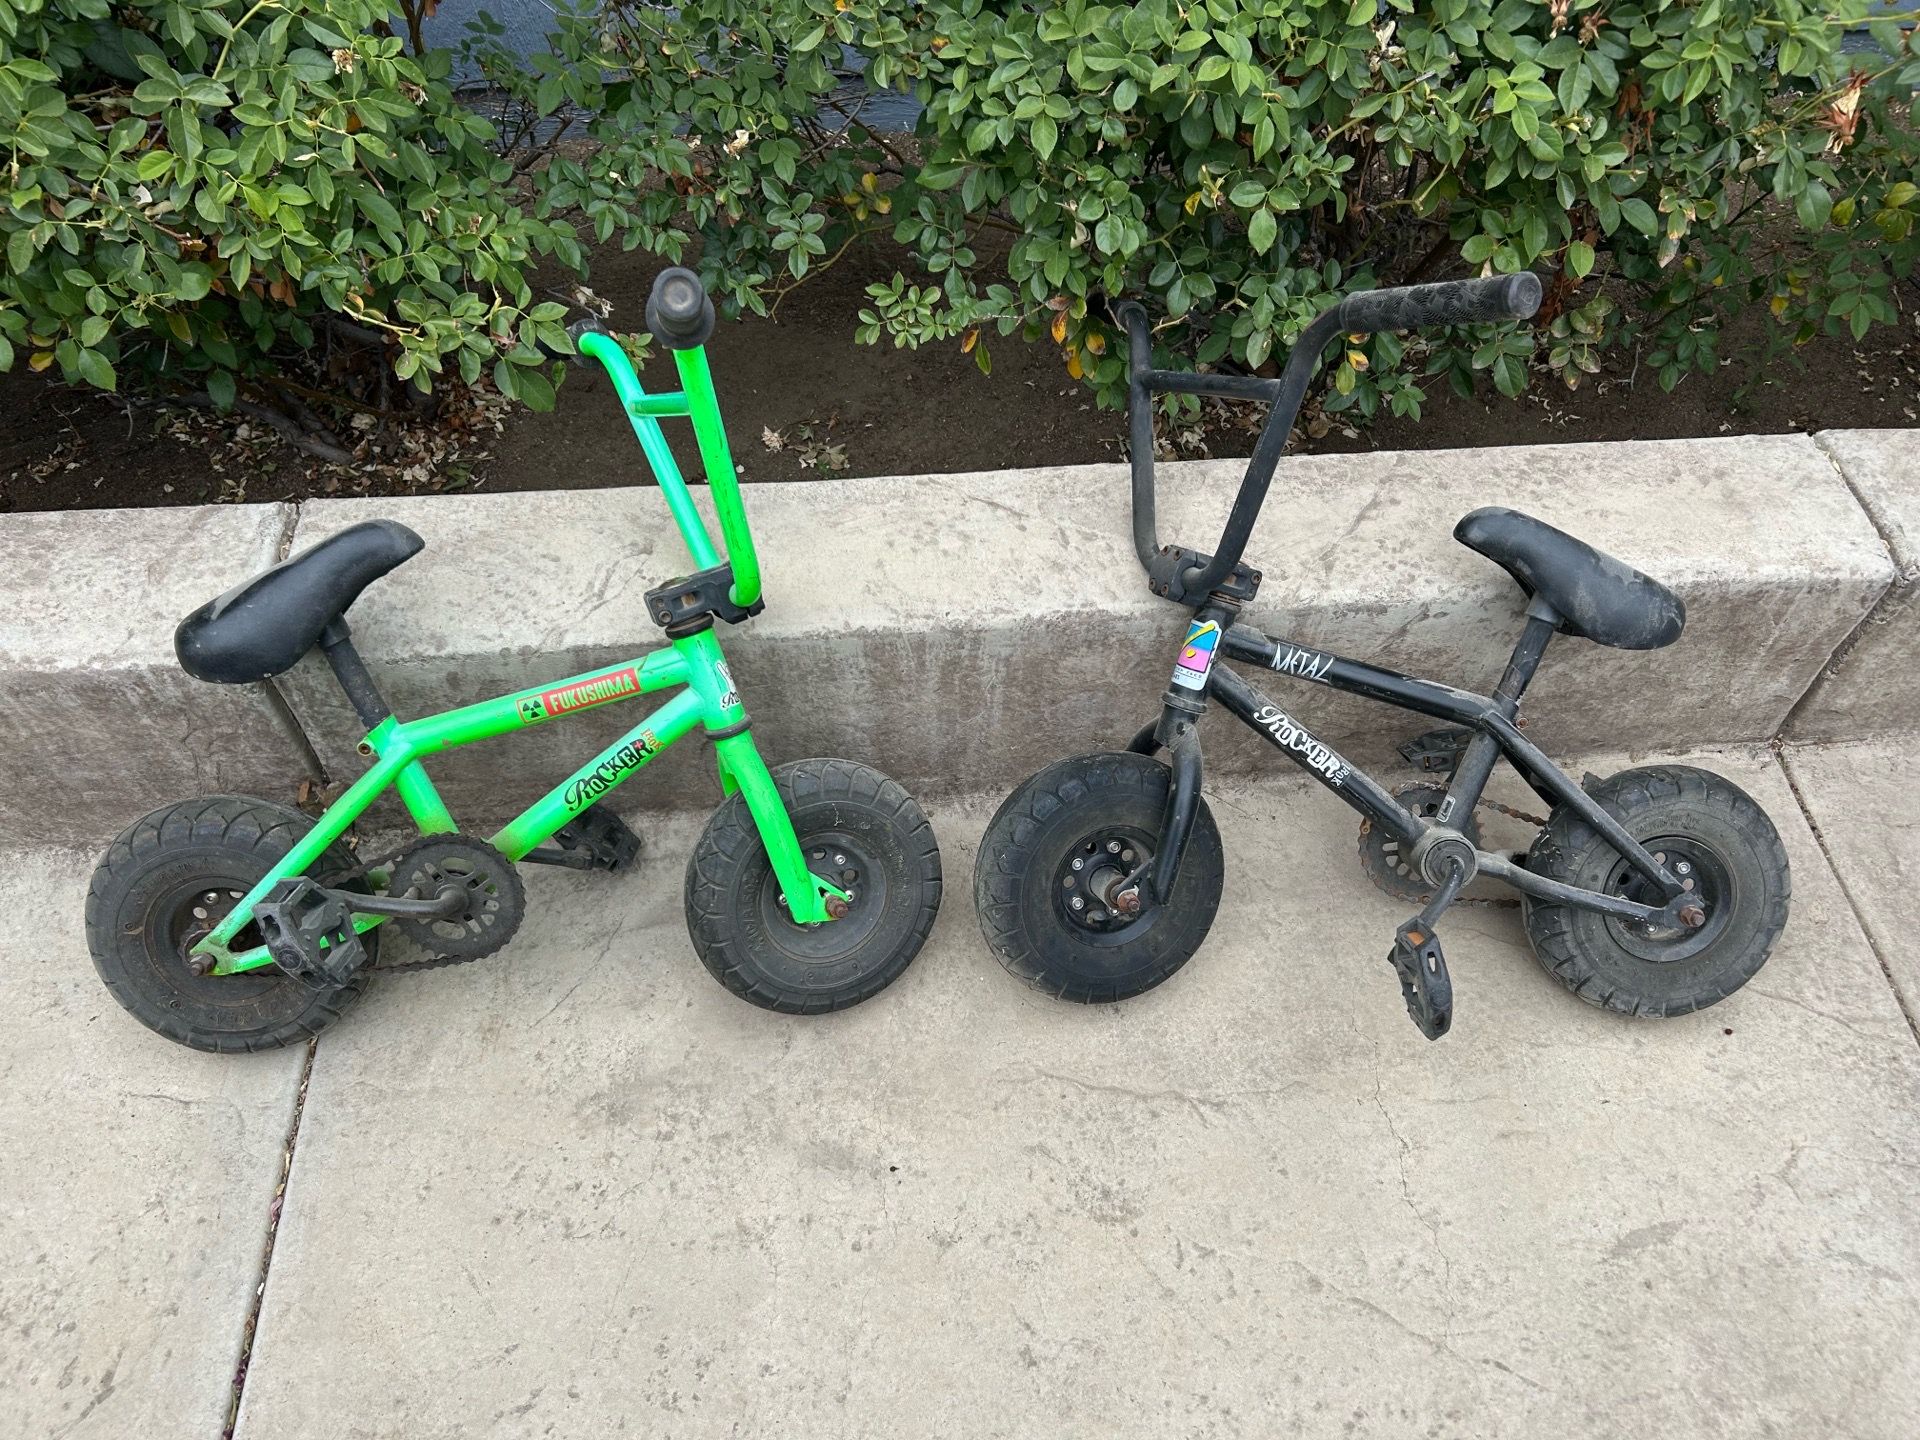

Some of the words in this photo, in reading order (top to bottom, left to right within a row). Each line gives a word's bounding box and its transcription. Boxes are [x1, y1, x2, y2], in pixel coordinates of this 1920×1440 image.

[1271, 643, 1335, 683] METAL
[551, 673, 635, 712] FUKUSHIMA
[1253, 705, 1340, 778] ROCKER
[564, 738, 654, 812] ROCKER
